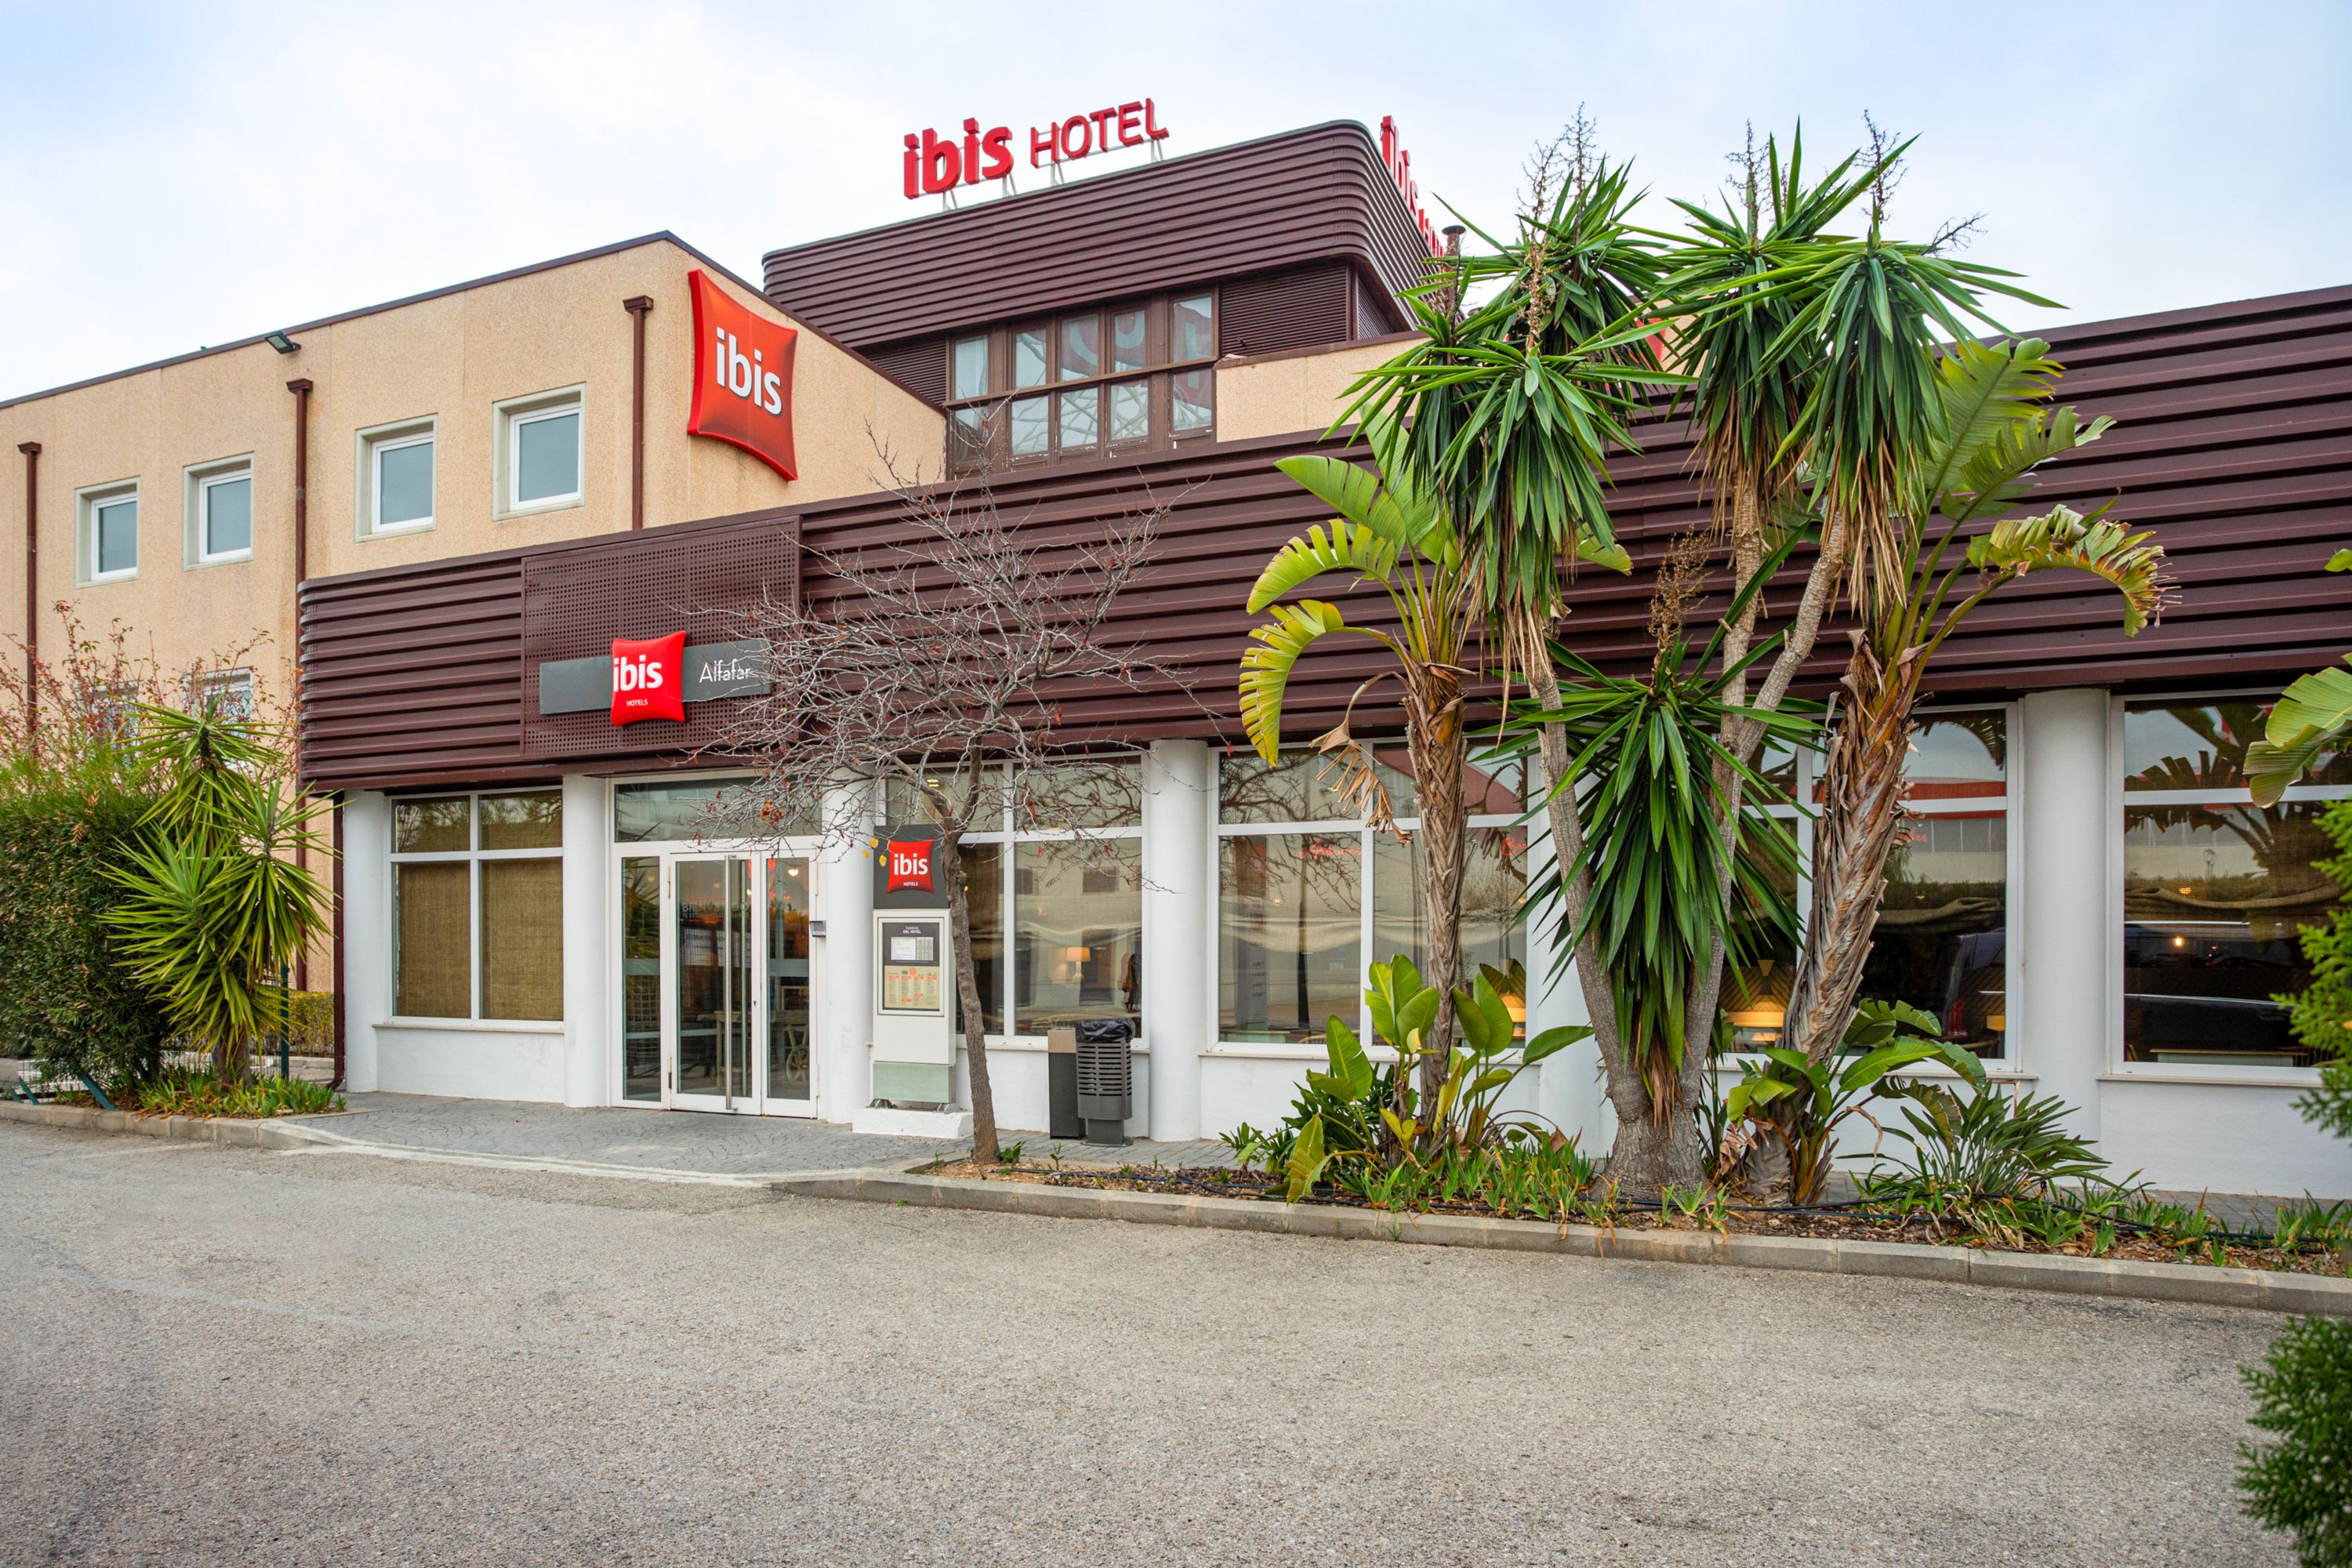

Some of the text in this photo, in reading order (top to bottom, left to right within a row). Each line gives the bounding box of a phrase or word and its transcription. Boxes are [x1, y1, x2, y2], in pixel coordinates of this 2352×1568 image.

[904, 98, 1169, 199] ibis HOTEL
[717, 326, 782, 416] ibis
[613, 655, 663, 692] ibis
[699, 659, 750, 683] Alfafar
[626, 699, 648, 707] HOTELS
[894, 853, 929, 876] ibis
